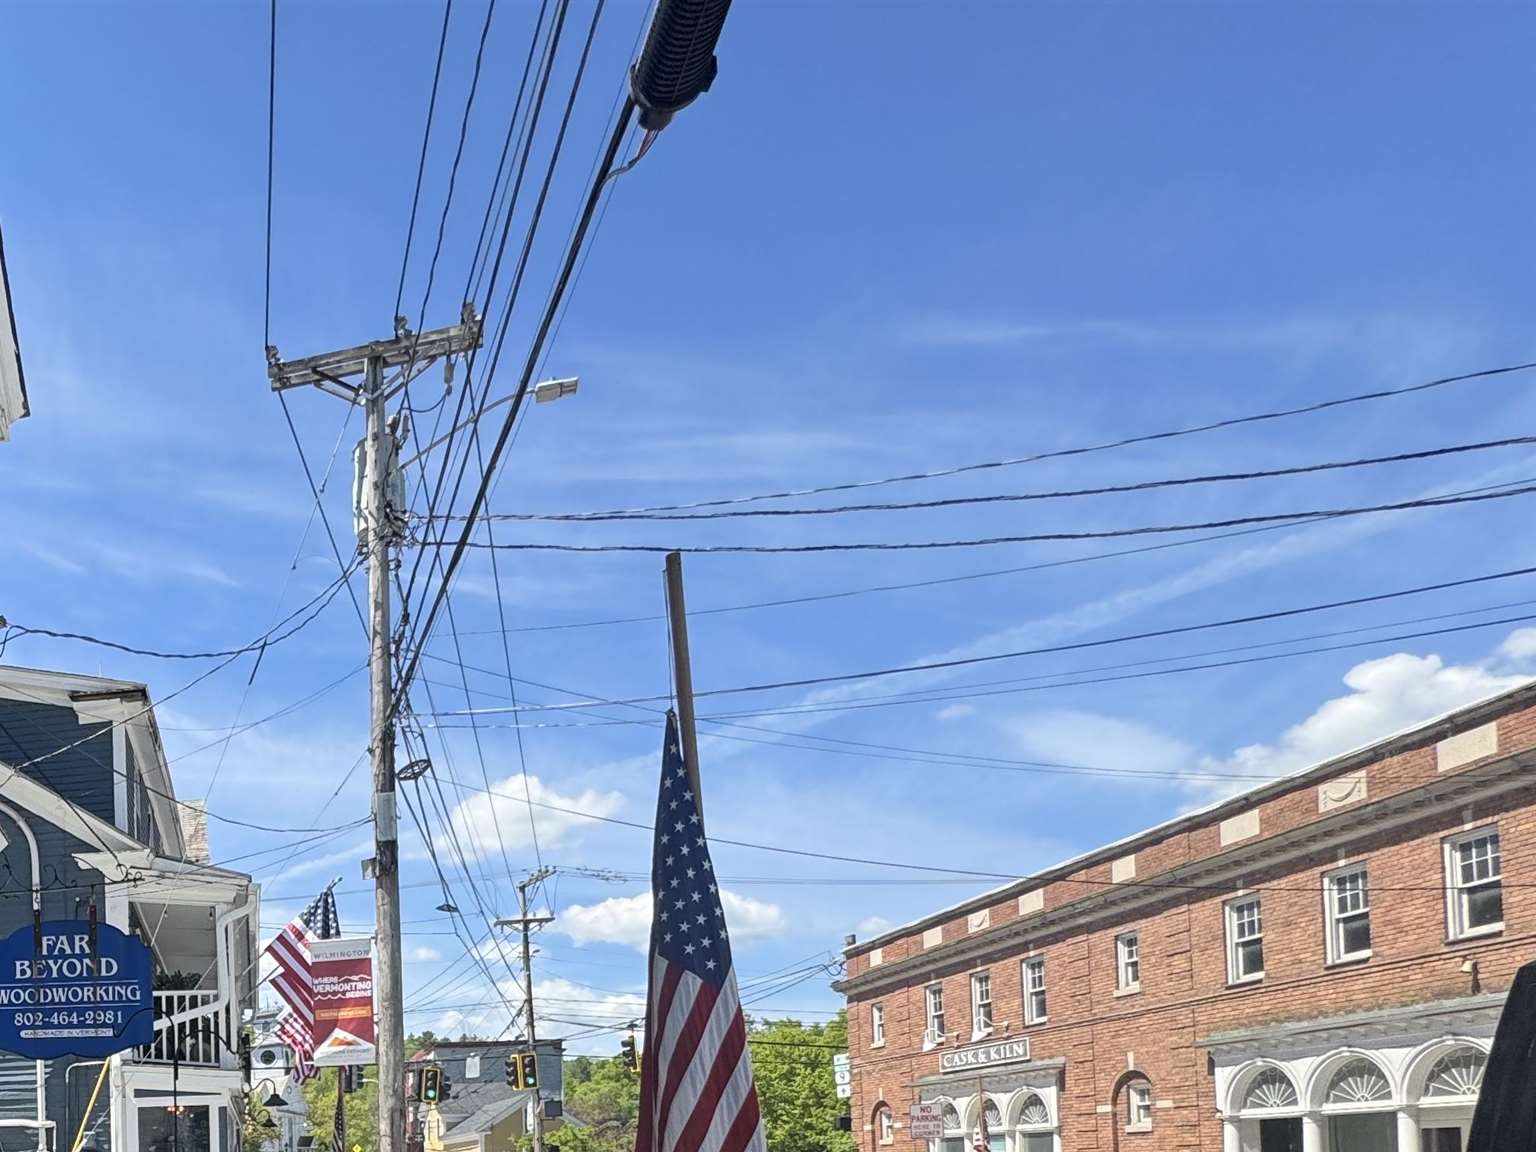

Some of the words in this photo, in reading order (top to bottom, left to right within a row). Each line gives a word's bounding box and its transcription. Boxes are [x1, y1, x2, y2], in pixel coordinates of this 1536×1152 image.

[41, 934, 91, 955] FAR
[314, 950, 370, 960] WILMINGTON
[15, 957, 118, 980] BEYOND
[14, 1010, 123, 1026] 802-464-2981
[944, 1050, 977, 1067] CASK
[978, 1048, 988, 1063] &
[990, 1042, 1024, 1061] KILN
[839, 1072, 846, 1083] 9
[920, 1105, 932, 1114] NO
[911, 1114, 942, 1122] PARKING
